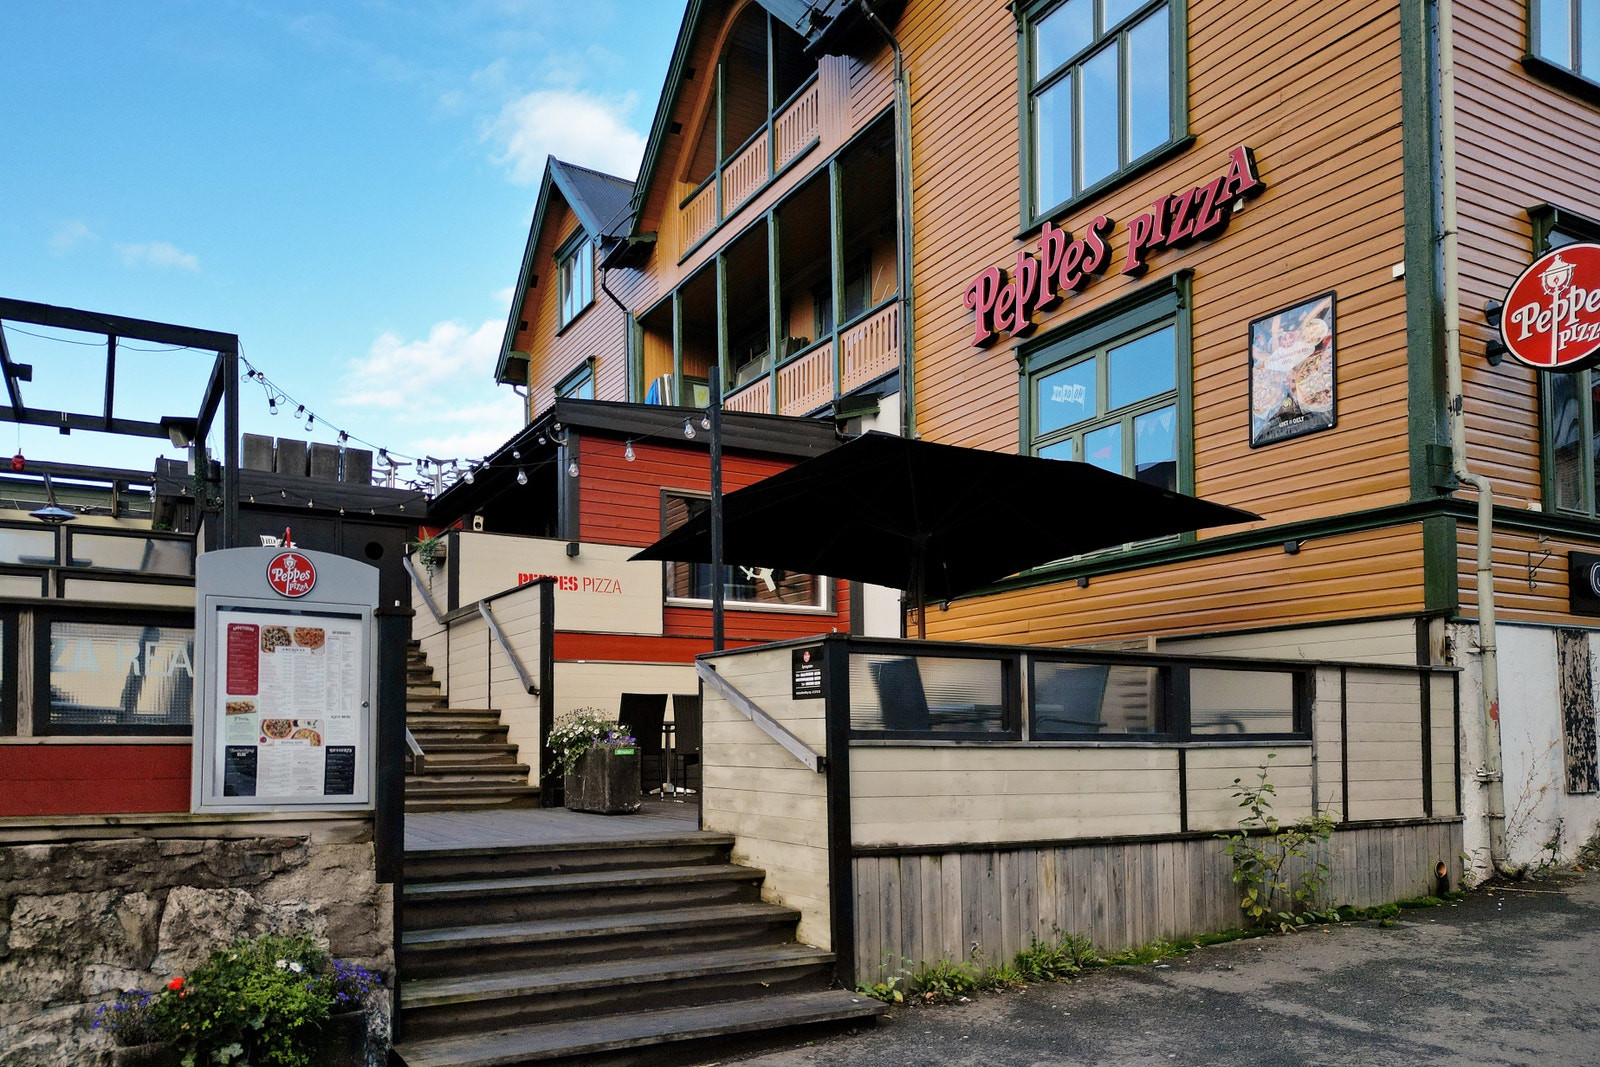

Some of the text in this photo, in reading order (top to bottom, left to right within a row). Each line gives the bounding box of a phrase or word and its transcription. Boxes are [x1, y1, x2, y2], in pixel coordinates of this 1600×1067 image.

[963, 215, 1108, 347] Peppes
[1558, 320, 1600, 350] PIZZ
[271, 567, 311, 583] Peppes
[583, 577, 622, 594] PIZZA
